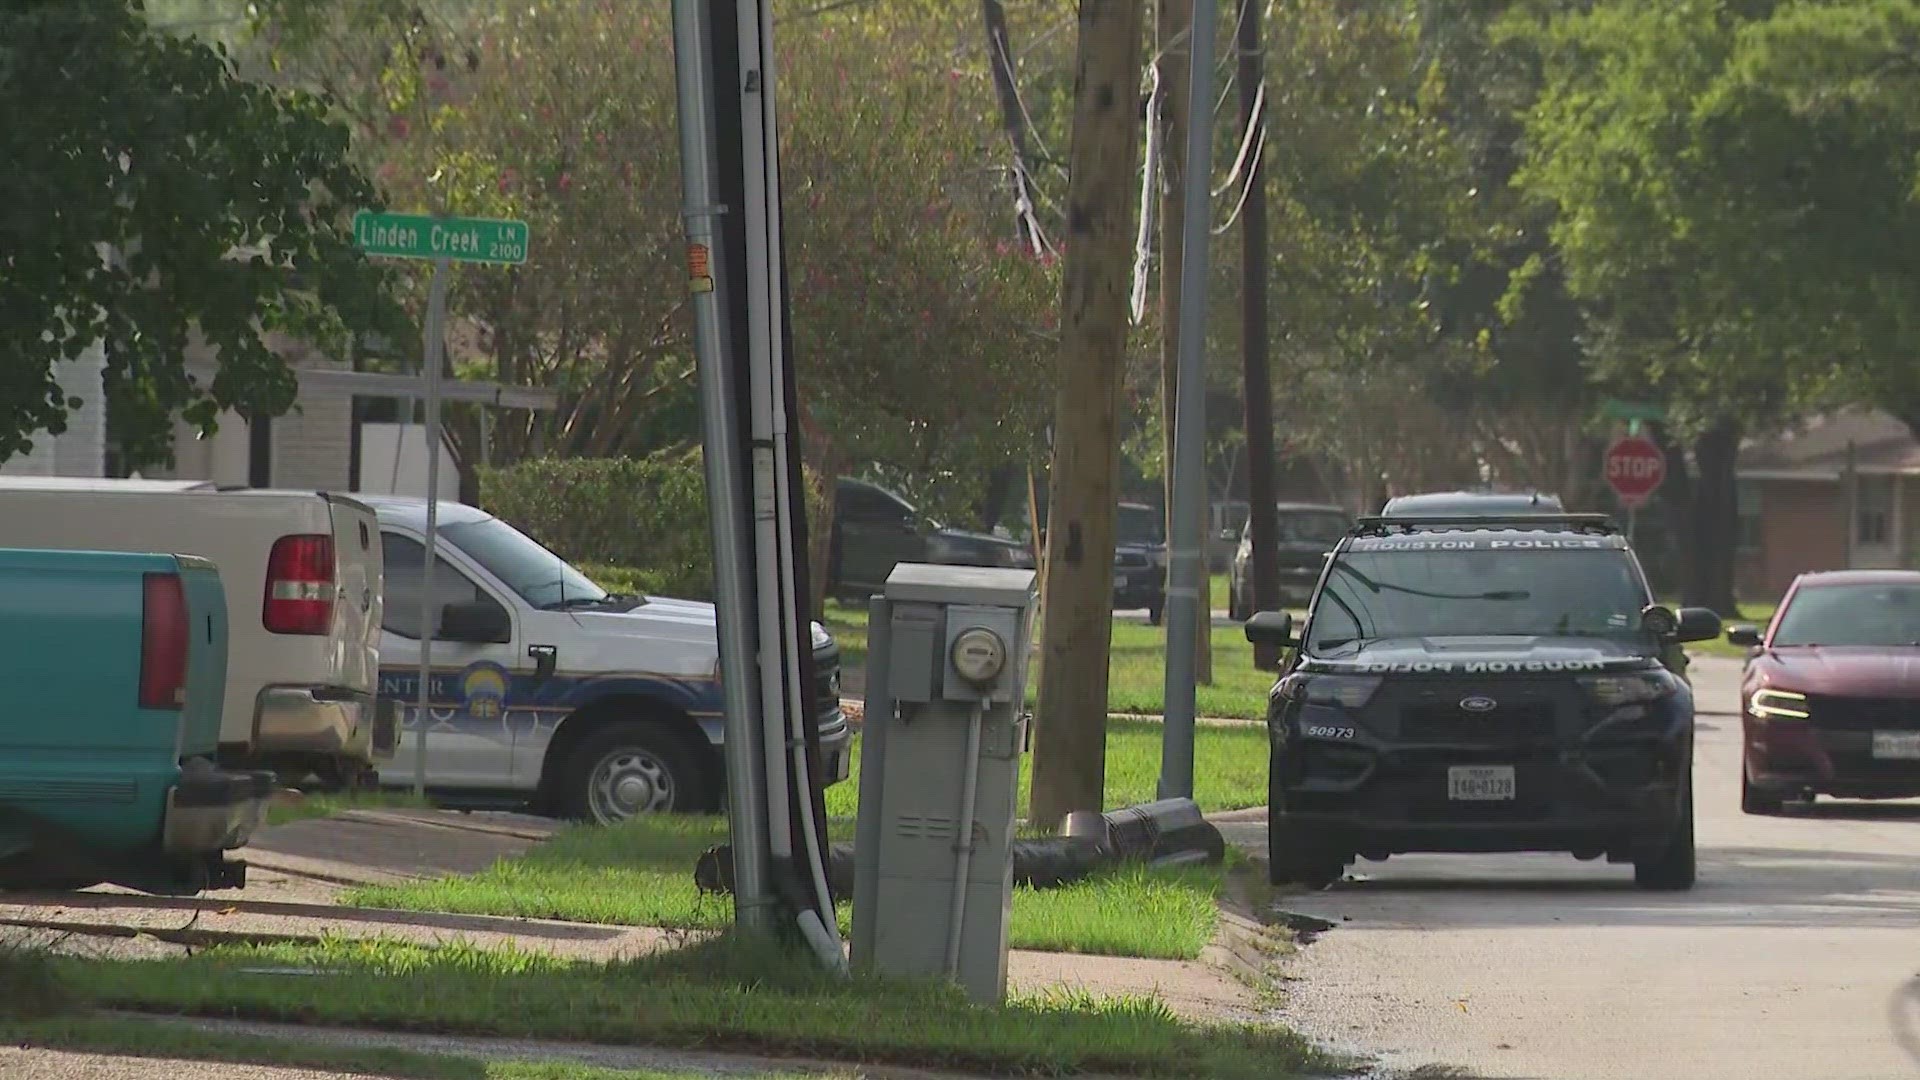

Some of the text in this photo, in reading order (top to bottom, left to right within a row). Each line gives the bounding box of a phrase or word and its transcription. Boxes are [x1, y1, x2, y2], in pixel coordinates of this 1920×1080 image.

[360, 220, 479, 252] Linden Creek
[498, 227, 516, 241] LN
[489, 243, 522, 259] 2100
[1609, 455, 1660, 478] STOP
[1363, 540, 1602, 551] HOUSTON POLICE
[377, 677, 443, 694] NTR
[1308, 726, 1355, 739] 50973
